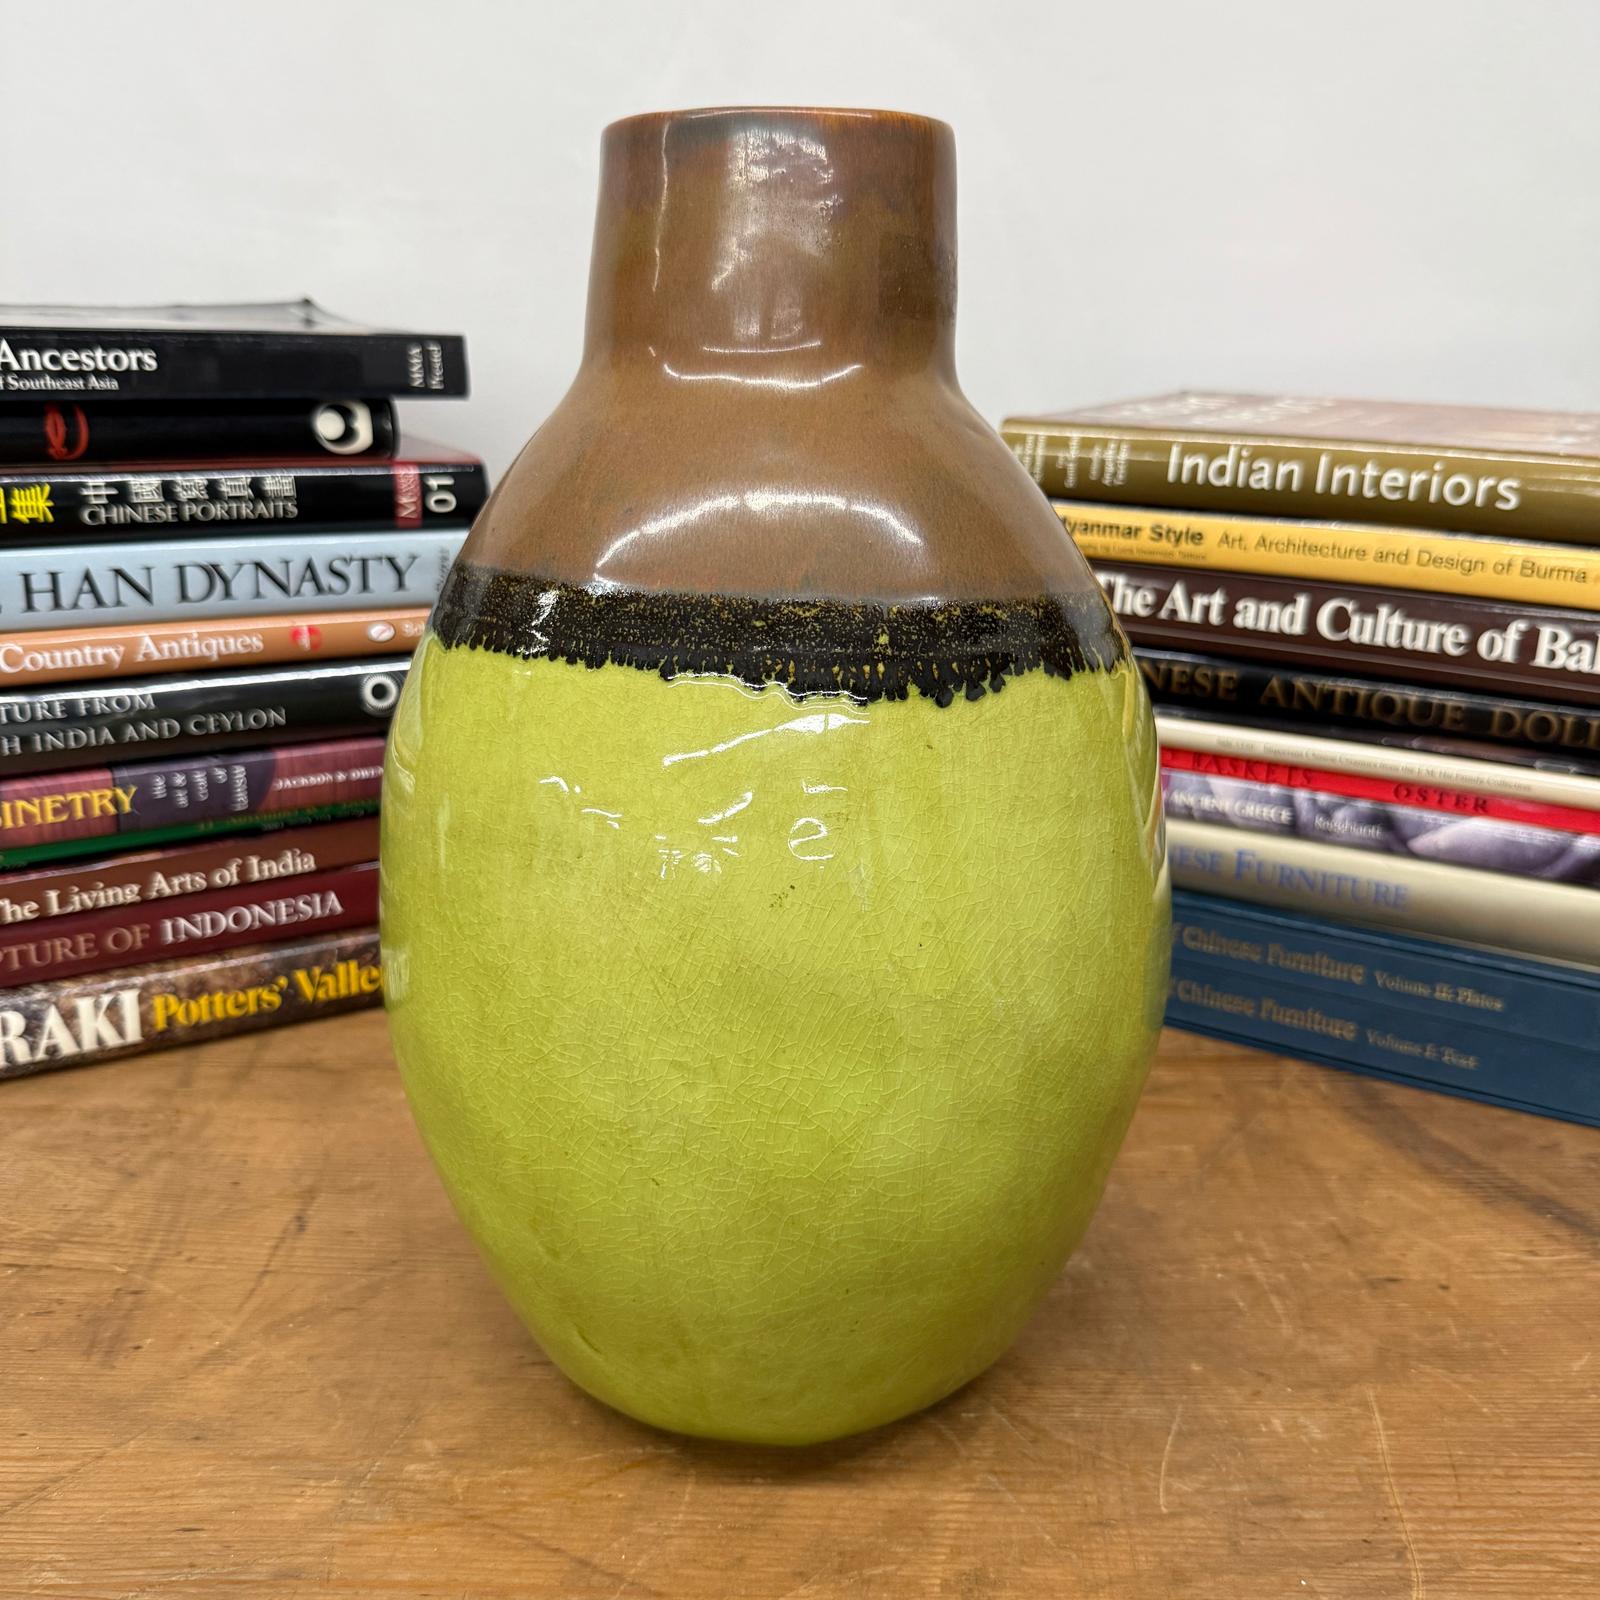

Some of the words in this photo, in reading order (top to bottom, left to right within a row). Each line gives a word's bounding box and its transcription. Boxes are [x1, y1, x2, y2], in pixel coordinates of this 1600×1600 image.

[0, 337, 158, 371] Ancestors
[6, 373, 85, 391] Southeast
[86, 374, 120, 391] Asia
[424, 475, 457, 514] 01
[1167, 442, 1302, 493] Indian
[1314, 450, 1521, 511] Interiors
[0, 482, 55, 525] 集
[80, 503, 179, 526] CHINESE
[181, 498, 299, 523] PORTRAITS
[1150, 524, 1204, 547] Style
[1218, 531, 1248, 551] Art,
[1255, 535, 1366, 561] Architecture
[1373, 549, 1409, 566] and
[1416, 550, 1485, 576] Design
[1493, 558, 1514, 576] of
[1520, 559, 1588, 584] Burma
[20, 565, 155, 614] HAN
[174, 554, 421, 604] DYNASTY
[1158, 580, 1228, 626] Art
[1233, 592, 1312, 635] and
[1316, 597, 1472, 657] Culture
[1477, 619, 1531, 664] of
[0, 642, 126, 674] Country
[135, 631, 264, 662] Antiques
[79, 692, 157, 718] FROM
[1259, 676, 1466, 731] ANTIQUE
[31, 726, 116, 753] INDIA
[120, 718, 182, 743] AND
[184, 706, 287, 736] CEYLON
[335, 769, 348, 783] &
[1393, 783, 1489, 813] OSTER
[0, 784, 138, 830] INETRY
[1234, 800, 1295, 825] GREECE
[0, 898, 40, 925] he
[45, 881, 142, 917] Living
[148, 871, 208, 900] Arts
[213, 857, 242, 888] of
[246, 848, 317, 883] India
[0, 932, 100, 972] TURE
[106, 923, 151, 954] OF
[159, 890, 344, 946] INDONESIA
[1183, 926, 1263, 963] Chinese
[1267, 943, 1367, 985] Furniture
[1374, 970, 1431, 998] Volume
[0, 988, 145, 1069] RAKI
[1178, 979, 1255, 1017] Chinese
[1259, 997, 1358, 1041] Furniture
